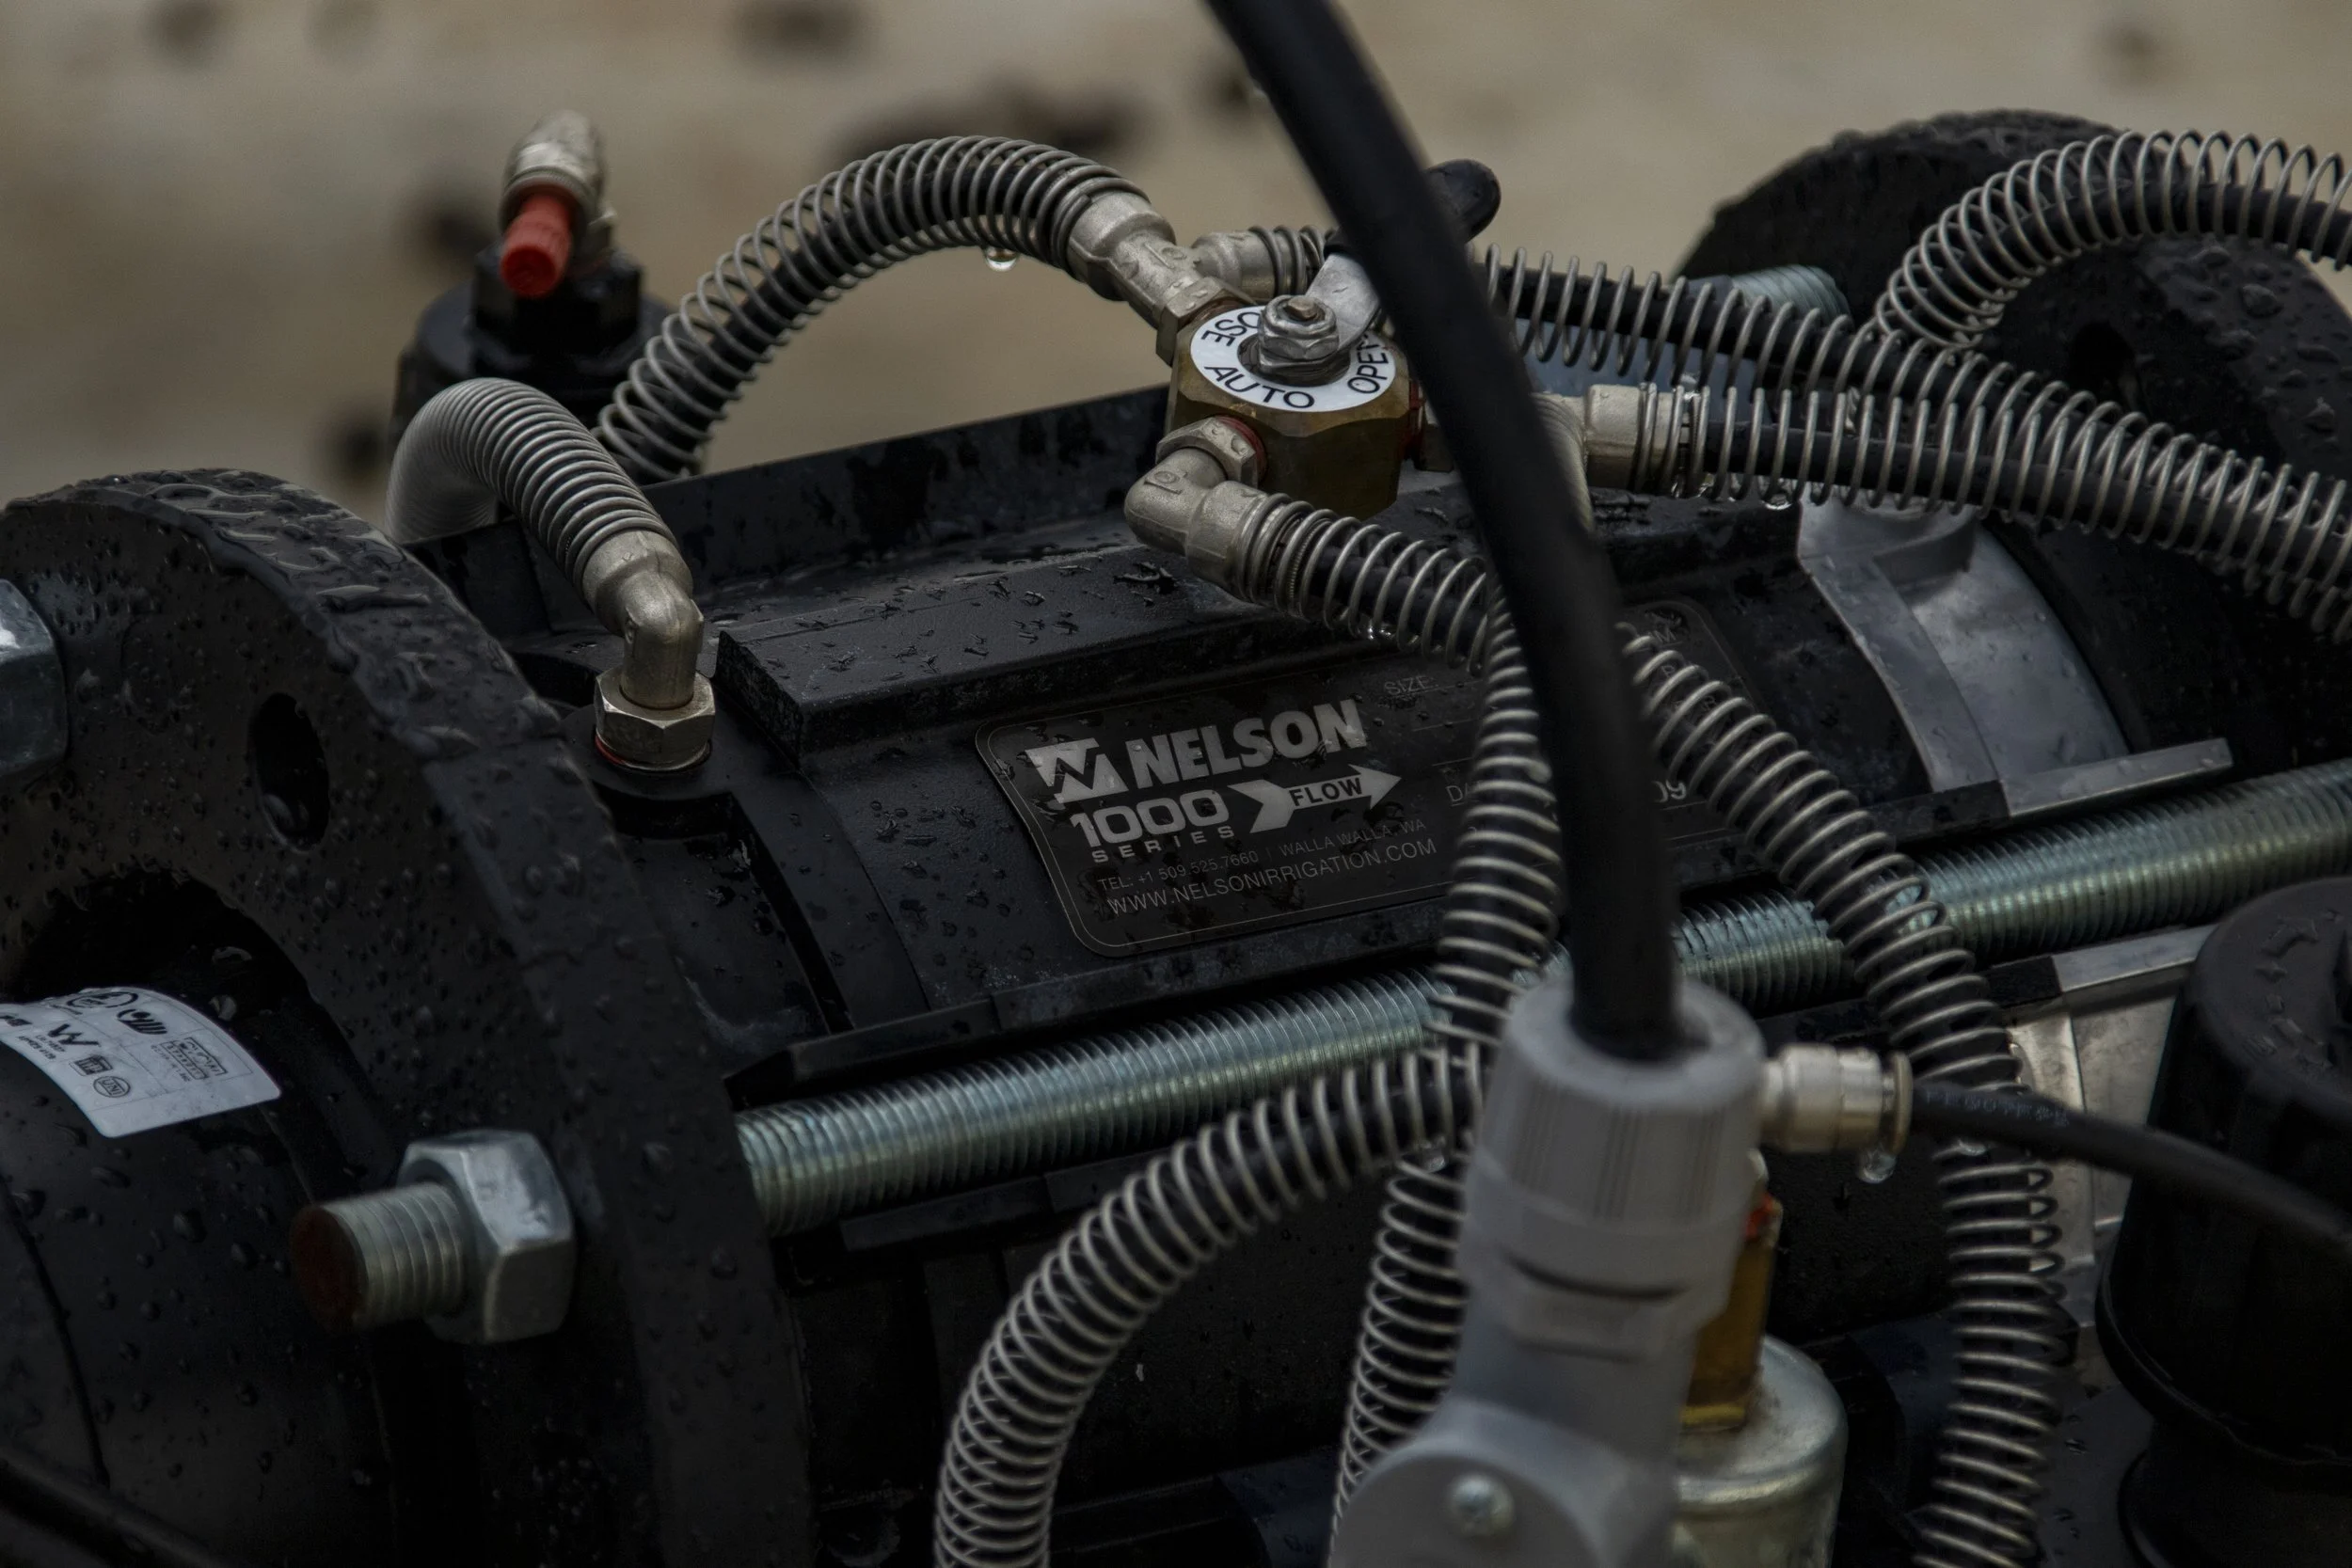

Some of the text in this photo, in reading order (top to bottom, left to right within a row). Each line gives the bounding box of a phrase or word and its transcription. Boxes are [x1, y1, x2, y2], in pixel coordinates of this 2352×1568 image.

[1200, 311, 1262, 347] OSE
[1204, 365, 1315, 409] AUTO
[1124, 698, 1368, 789] NELSON
[1069, 788, 1231, 848] 1000
[1288, 777, 1363, 807] FLOW
[1091, 825, 1236, 863] SERIES
[1098, 876, 1135, 892] TEL:
[1137, 871, 1154, 884] +1
[1158, 850, 1260, 881] 509.525.7660
[1279, 836, 1335, 857] WALLA
[1400, 818, 1427, 835] WA
[1106, 837, 1438, 917] WWW.NELSONIRRIGATION.COM
